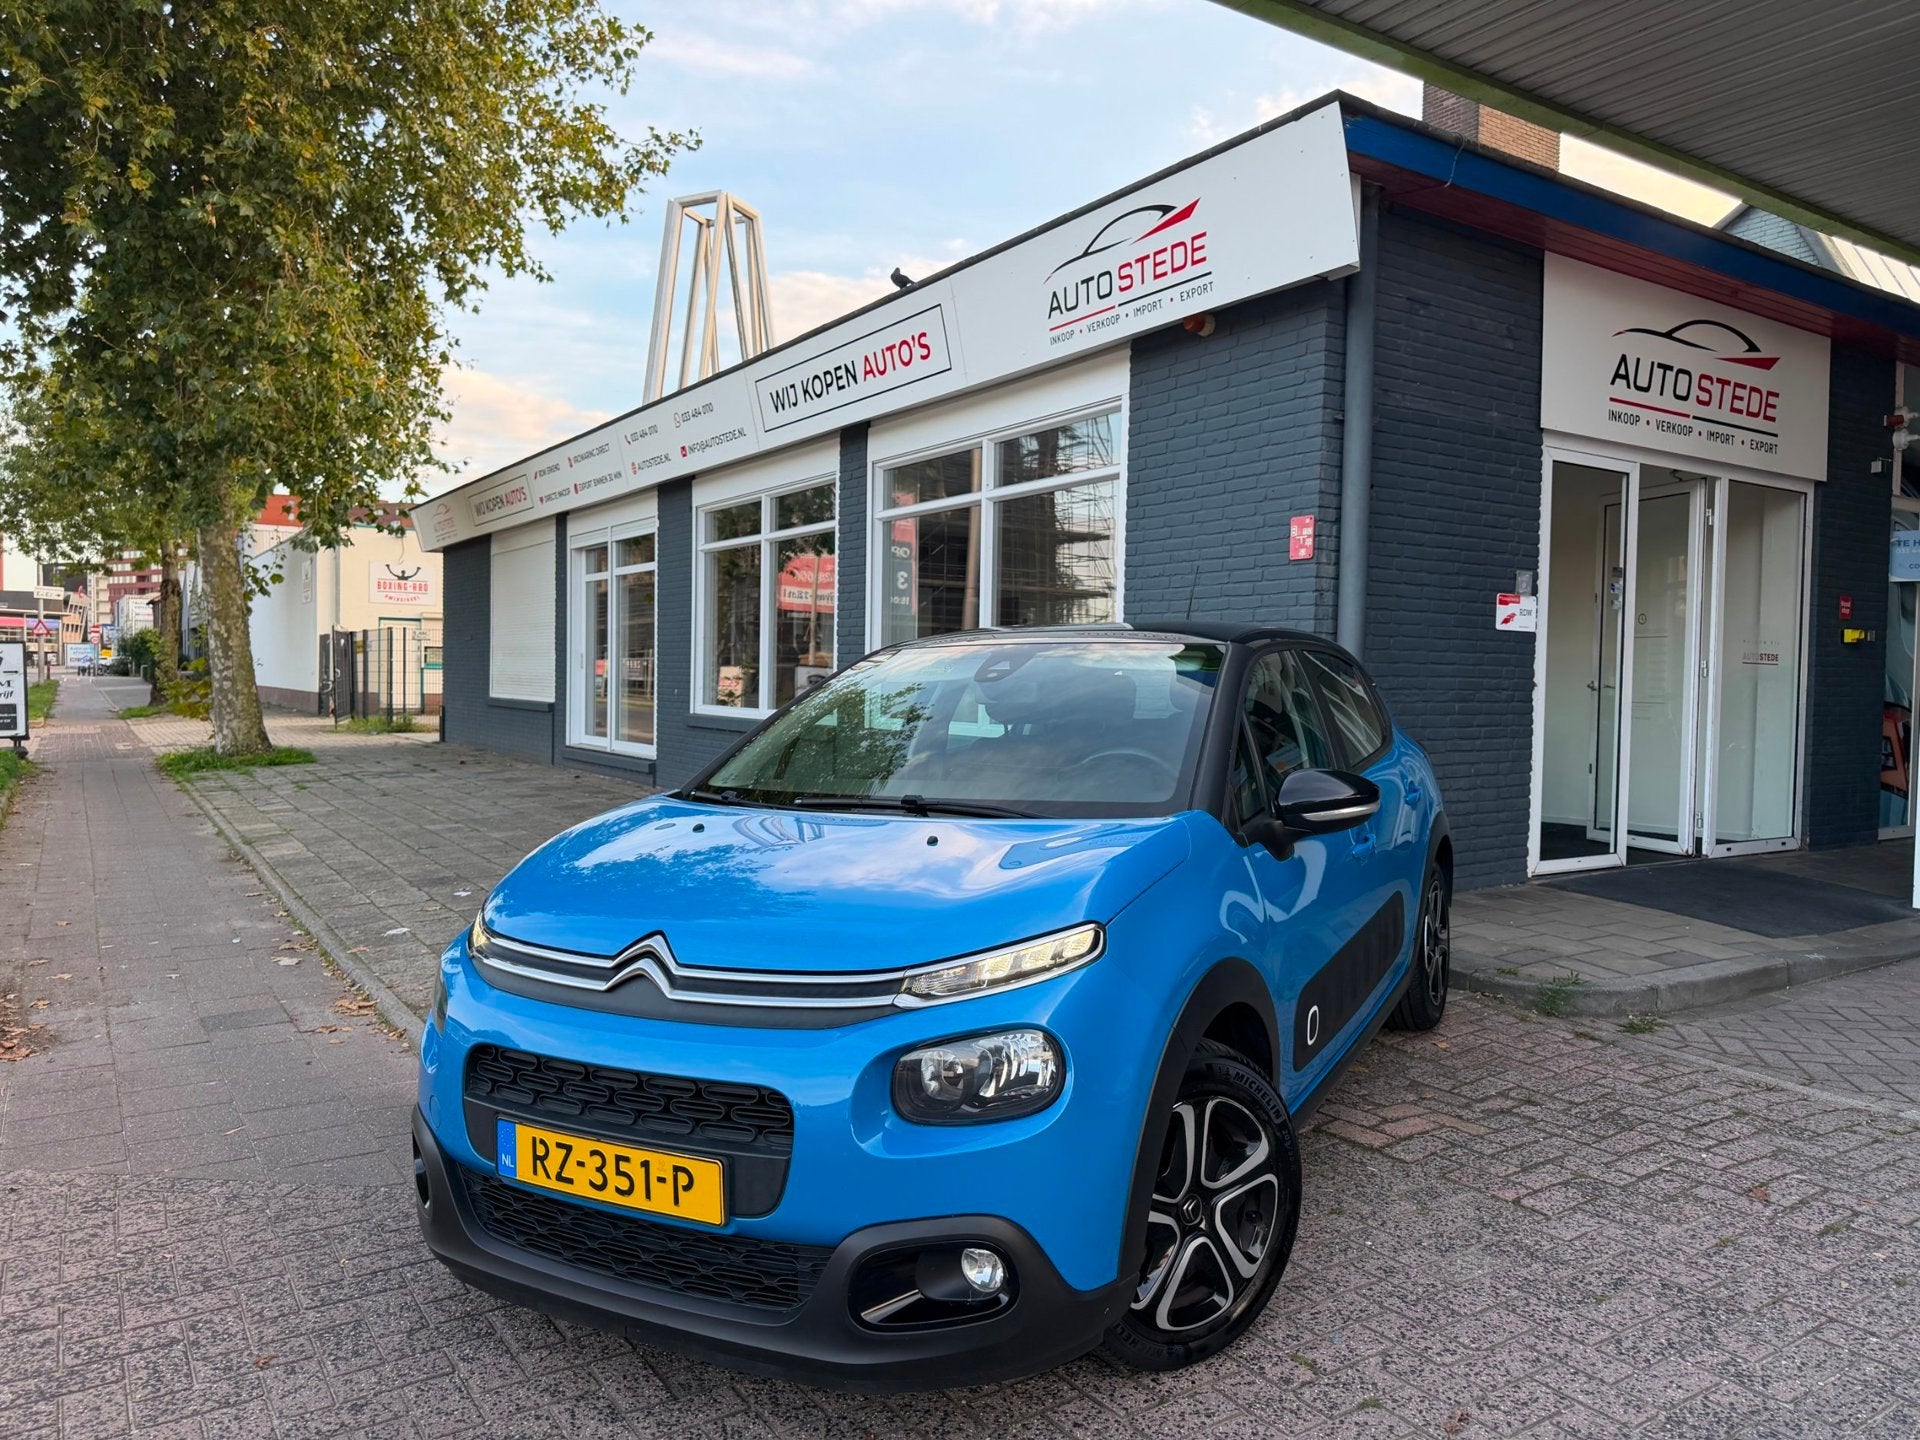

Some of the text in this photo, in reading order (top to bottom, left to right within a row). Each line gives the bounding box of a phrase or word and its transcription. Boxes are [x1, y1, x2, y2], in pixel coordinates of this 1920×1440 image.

[1047, 231, 1207, 319] AUTOSTEDE
[1049, 281, 1214, 346] INKOOP VERKOOP IMPORT EXPORT
[769, 331, 932, 413] WIJ KOPEN AUTO'S
[1609, 353, 1780, 423] AUTOSTEDE
[688, 426, 747, 455] INFO@AUTOSTEDE.NL
[1608, 408, 1779, 455] INKOOP VERKOOP IMPORT EXPORT
[1233, 1071, 1283, 1120] MICHELIN
[501, 1153, 514, 1168] NL
[531, 1135, 695, 1207] RZ-351-P
